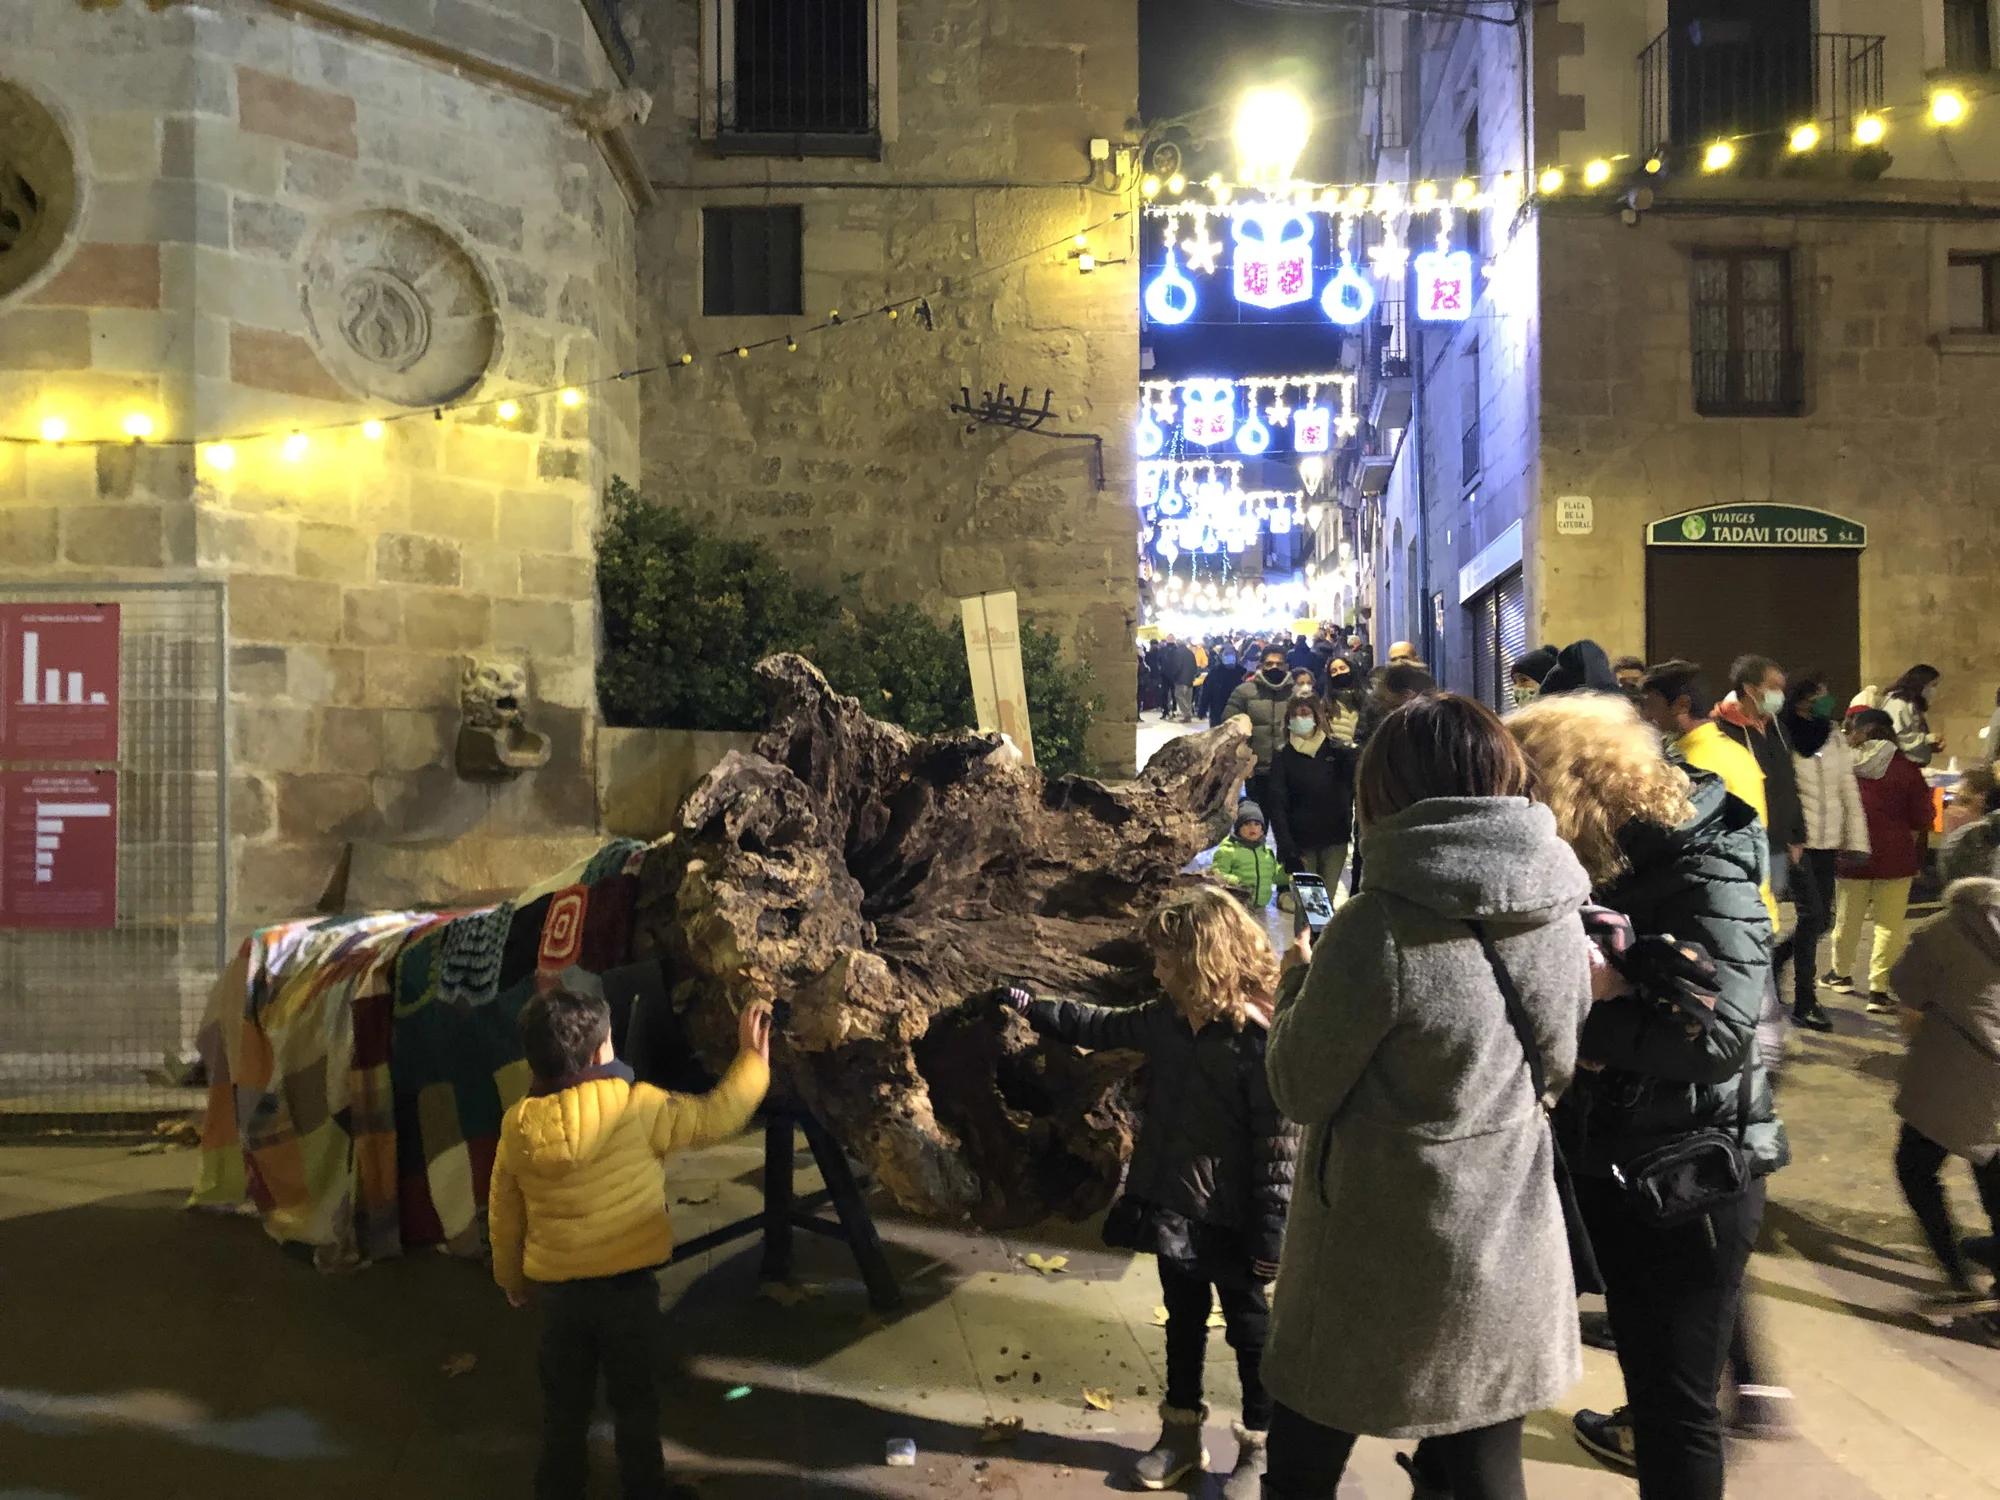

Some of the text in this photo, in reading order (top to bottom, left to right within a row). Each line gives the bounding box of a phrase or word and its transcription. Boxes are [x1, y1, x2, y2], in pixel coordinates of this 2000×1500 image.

[1564, 511, 1585, 519] DE LA
[1712, 512, 1755, 523] VIATGES
[1558, 520, 1592, 529] CATEDRAL
[1712, 526, 1858, 543] TADAVI TOURS S.L.
